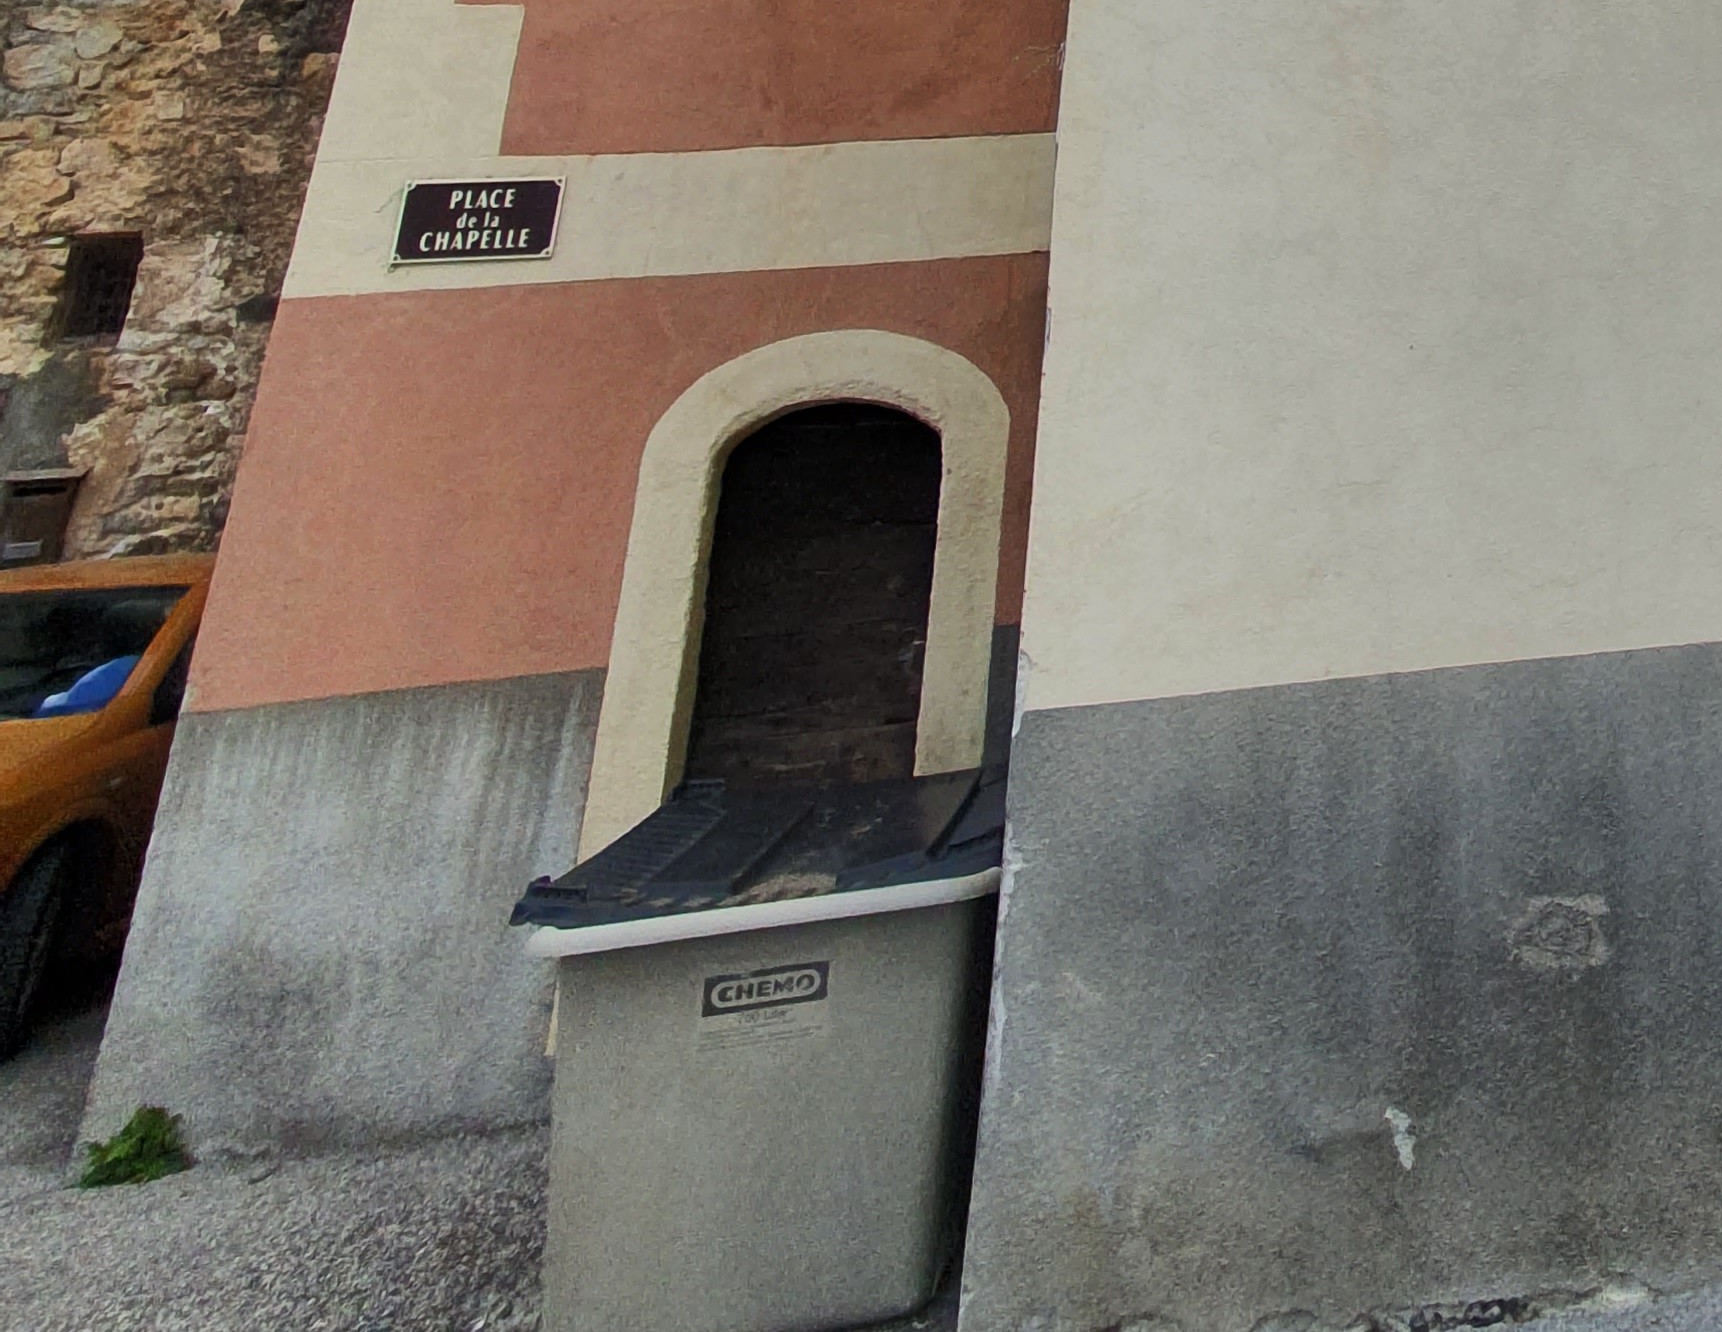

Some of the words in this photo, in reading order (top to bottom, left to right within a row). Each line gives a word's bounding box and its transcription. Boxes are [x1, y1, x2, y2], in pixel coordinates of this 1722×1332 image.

[449, 189, 516, 209] PLACE
[456, 212, 477, 229] de
[484, 211, 500, 228] la
[419, 228, 530, 252] CHAPELLE
[717, 974, 815, 1002] CHEMO
